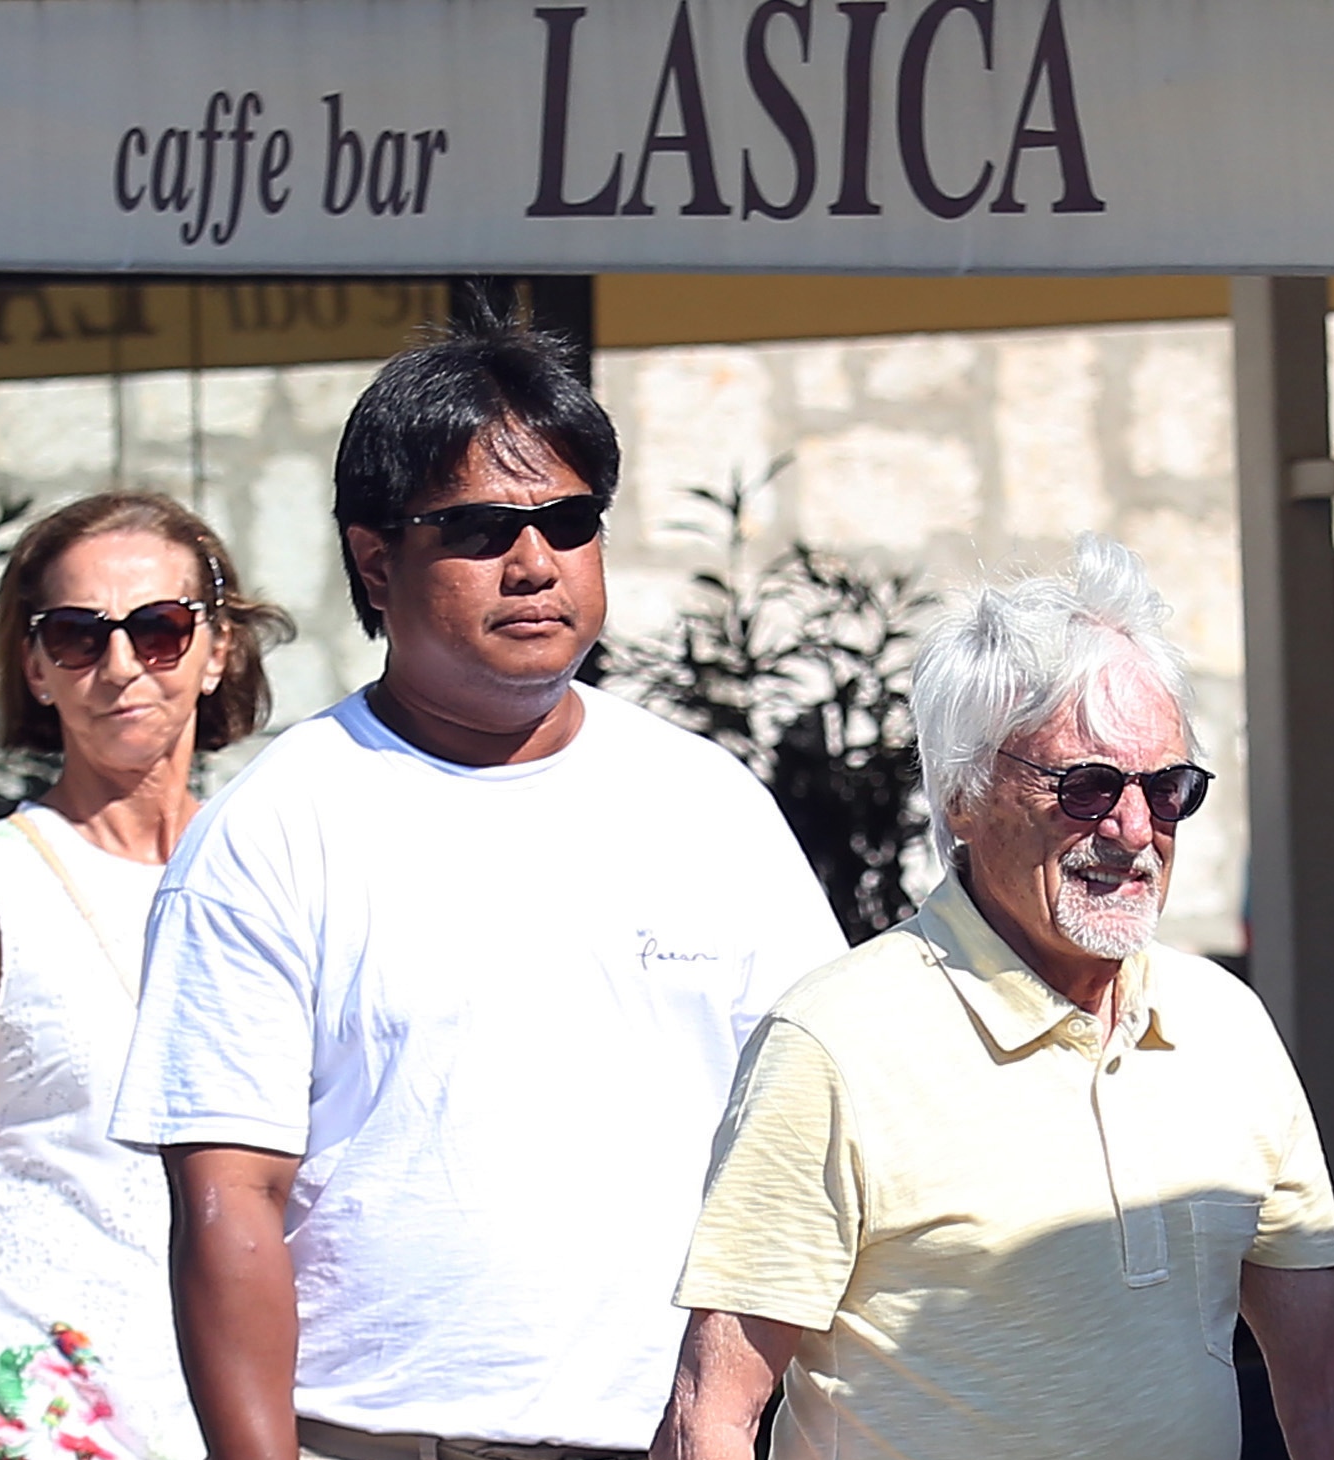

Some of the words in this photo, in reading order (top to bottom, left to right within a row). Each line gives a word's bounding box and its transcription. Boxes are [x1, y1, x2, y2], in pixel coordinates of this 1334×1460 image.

[114, 91, 292, 246] caffe
[322, 93, 447, 216] bar
[525, 0, 1106, 221] LASICA
